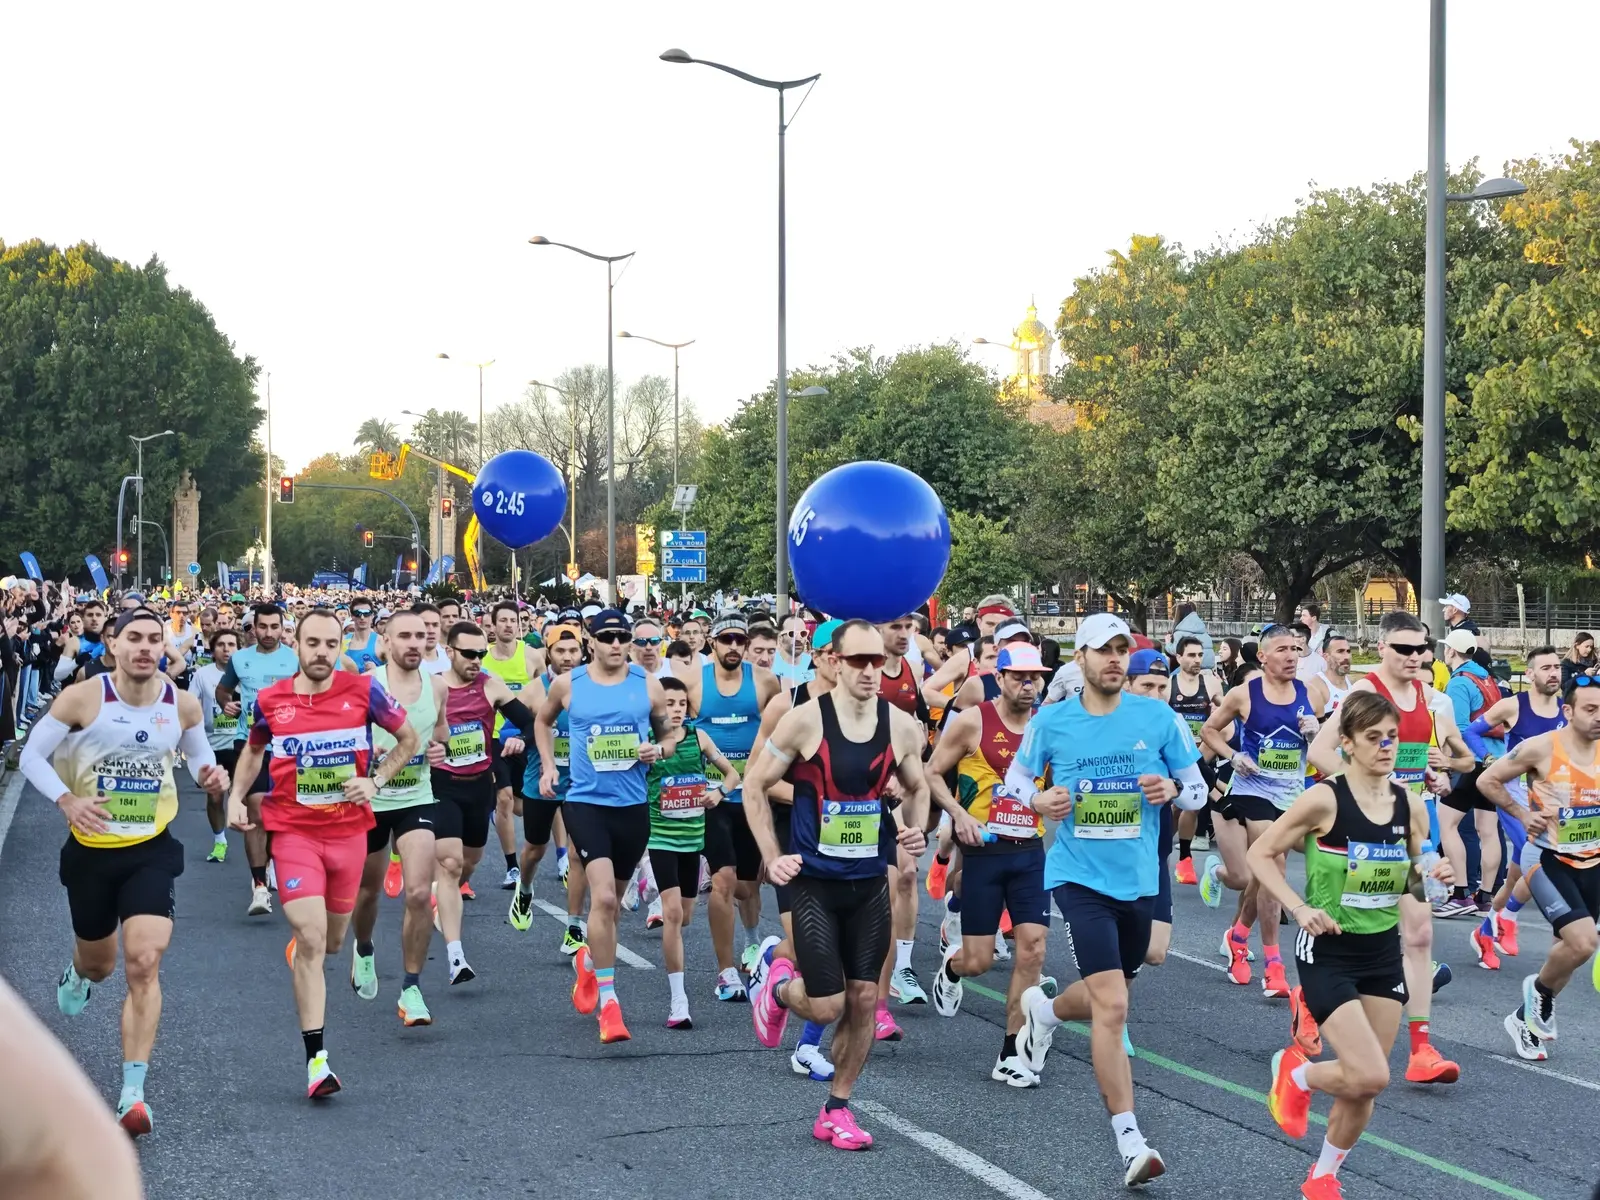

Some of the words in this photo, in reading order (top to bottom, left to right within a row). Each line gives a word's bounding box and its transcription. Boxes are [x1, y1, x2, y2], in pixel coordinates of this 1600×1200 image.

[496, 490, 525, 516] 2:45
[604, 725, 633, 733] ZURICH
[304, 738, 356, 753] Avanza
[474, 744, 483, 753] JR
[594, 748, 635, 760] DANIELE
[103, 759, 136, 770] SANTA
[317, 755, 349, 765] ZURICH
[1076, 754, 1135, 768] SANGIOVANNI
[1262, 760, 1298, 769] VAQUERO
[92, 765, 112, 774] LOS
[1095, 764, 1135, 777] LORENZO
[384, 778, 417, 788] ANDRO
[677, 776, 702, 784] ZURICH
[120, 781, 154, 790] ZURICH
[298, 783, 324, 793] FRAN
[1097, 782, 1133, 790] ZURICH
[120, 798, 137, 806] 1841
[662, 799, 690, 809] PACER
[1098, 800, 1118, 808] 1760
[844, 804, 876, 812] ZURICH
[119, 814, 156, 823] CARCELÉN
[996, 812, 1034, 826] RUBENS
[1081, 809, 1135, 825] JOAQUÍN
[844, 821, 861, 829] 1603
[840, 832, 862, 844] ROB
[1569, 831, 1597, 842] CINTIA
[1373, 848, 1404, 858] ZURIC
[1373, 868, 1391, 876] 1968
[1360, 880, 1394, 893] MARIA
